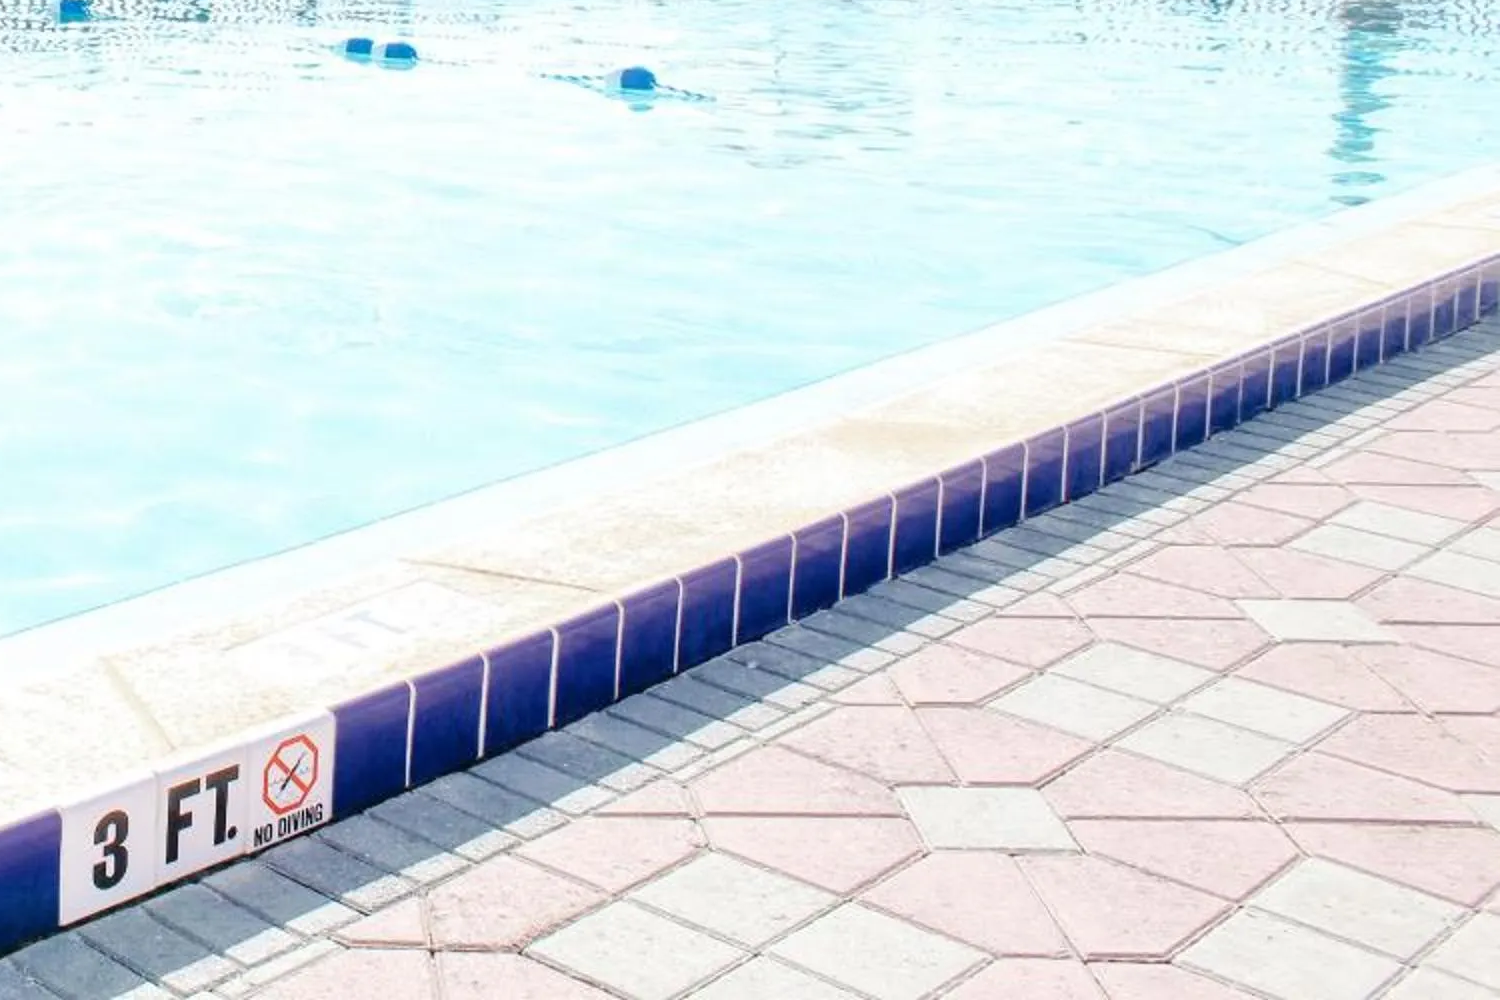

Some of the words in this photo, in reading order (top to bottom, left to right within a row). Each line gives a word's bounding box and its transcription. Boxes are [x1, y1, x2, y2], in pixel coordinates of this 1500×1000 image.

[93, 809, 129, 890] 3
[165, 764, 240, 865] FT.
[253, 823, 273, 847] NO
[278, 803, 323, 837] DIVING
